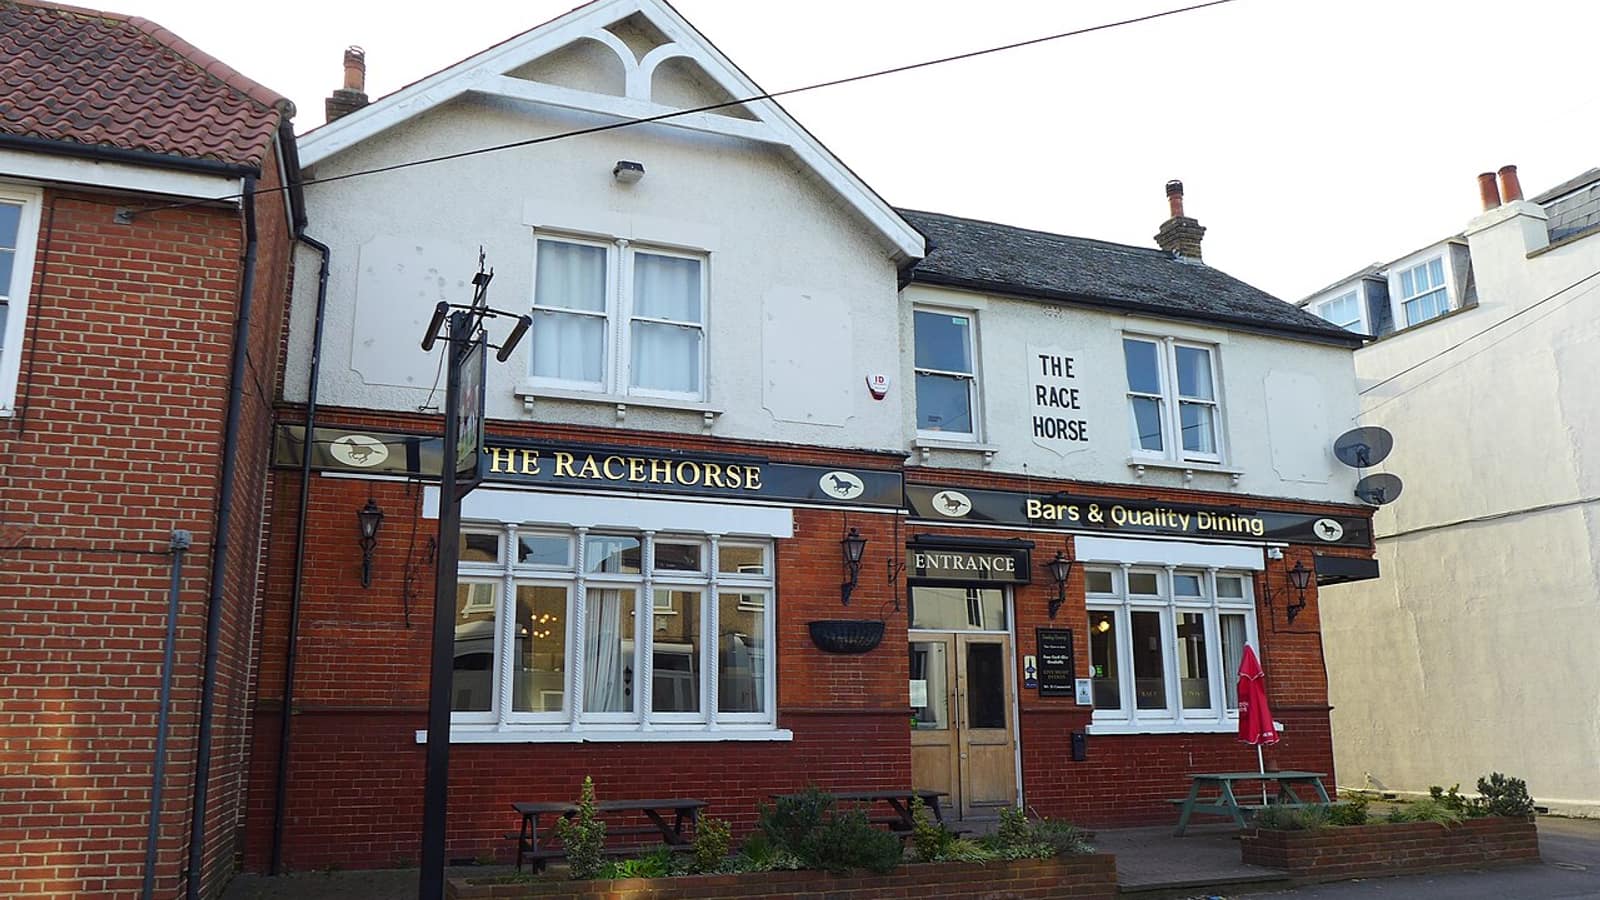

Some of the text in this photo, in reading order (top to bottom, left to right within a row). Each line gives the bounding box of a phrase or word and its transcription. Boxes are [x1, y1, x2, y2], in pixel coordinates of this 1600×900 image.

[1038, 354, 1075, 378] THE
[1035, 384, 1081, 410] RACE
[1032, 415, 1089, 442] HORSE
[484, 447, 763, 490] HE RACEHORSE
[1026, 499, 1264, 536] Bars & Quality Dining
[914, 553, 1016, 572] ENTRANCE
